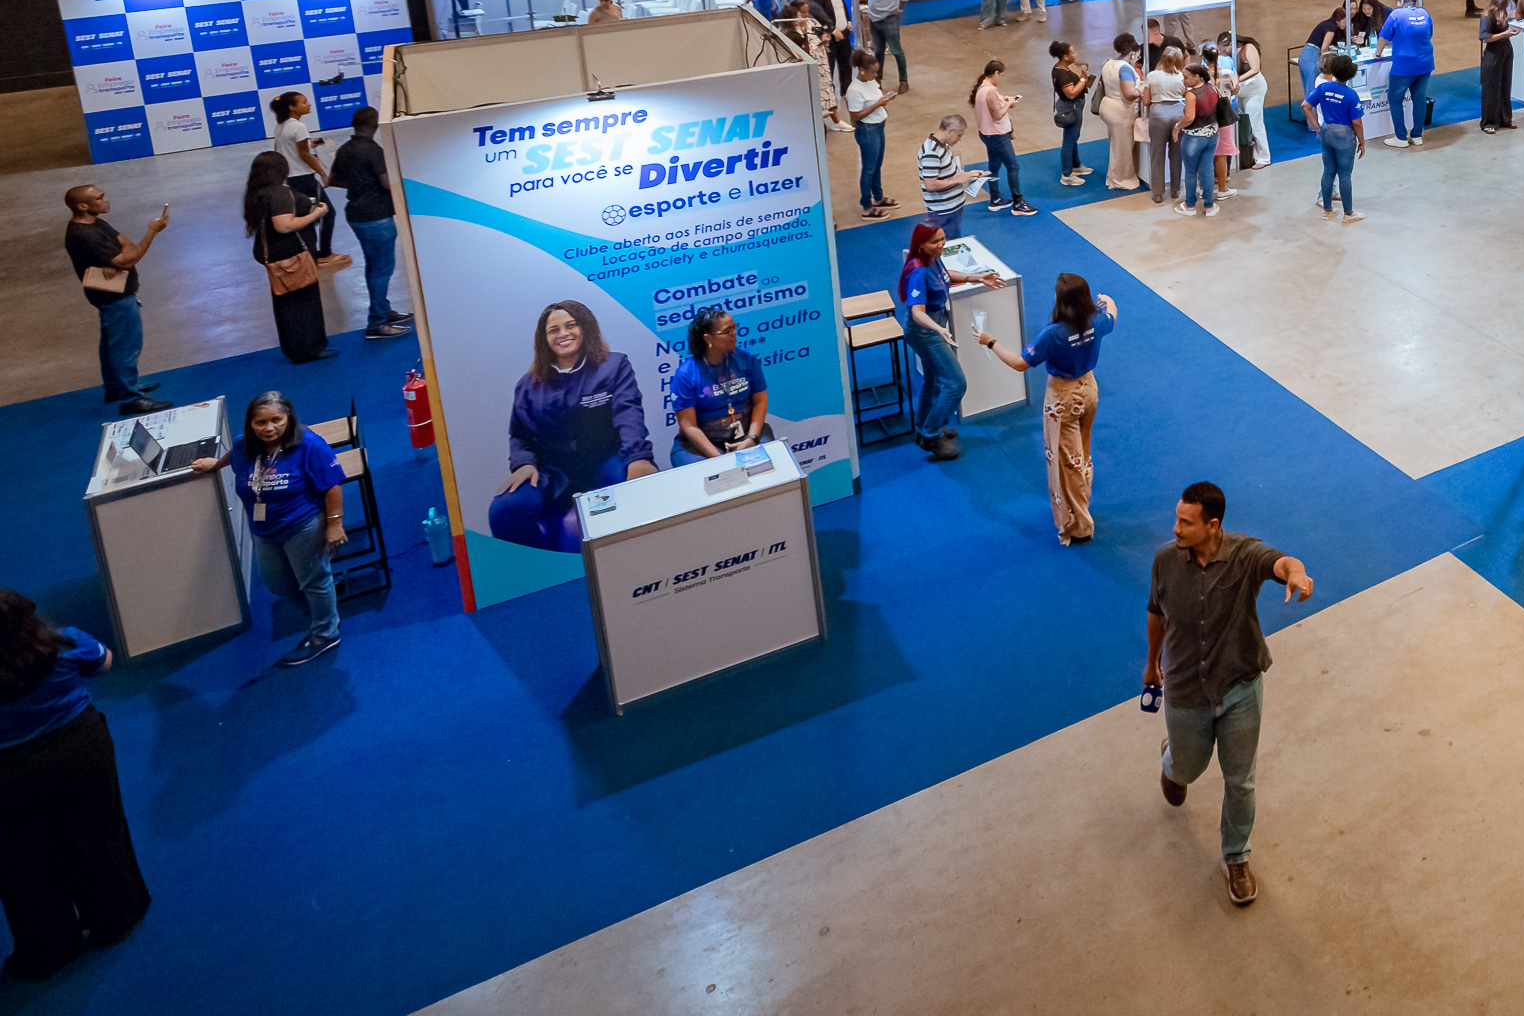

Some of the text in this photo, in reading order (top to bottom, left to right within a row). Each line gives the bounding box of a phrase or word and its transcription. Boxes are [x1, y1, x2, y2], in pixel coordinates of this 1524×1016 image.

[473, 109, 648, 148] Tem sempre
[485, 110, 774, 176] um SEST SENAT
[509, 140, 789, 197] para você se Divertir
[629, 174, 804, 220] esporte e lazer
[563, 204, 811, 261] Clube aberto aos Finais de semana
[602, 246, 667, 267] Locação
[670, 241, 689, 256] de
[693, 229, 743, 254] campo
[586, 263, 641, 284] campo
[644, 252, 695, 275] society
[699, 249, 708, 260] e
[653, 273, 779, 305] Combate ao
[656, 284, 807, 327] sedentarismo
[757, 309, 821, 333] adulto
[791, 435, 830, 453] SENAT
[799, 458, 814, 466] ENAT
[632, 540, 787, 598] CNT SEST SENAT ITL
[674, 565, 751, 595] Sistema Transporte
